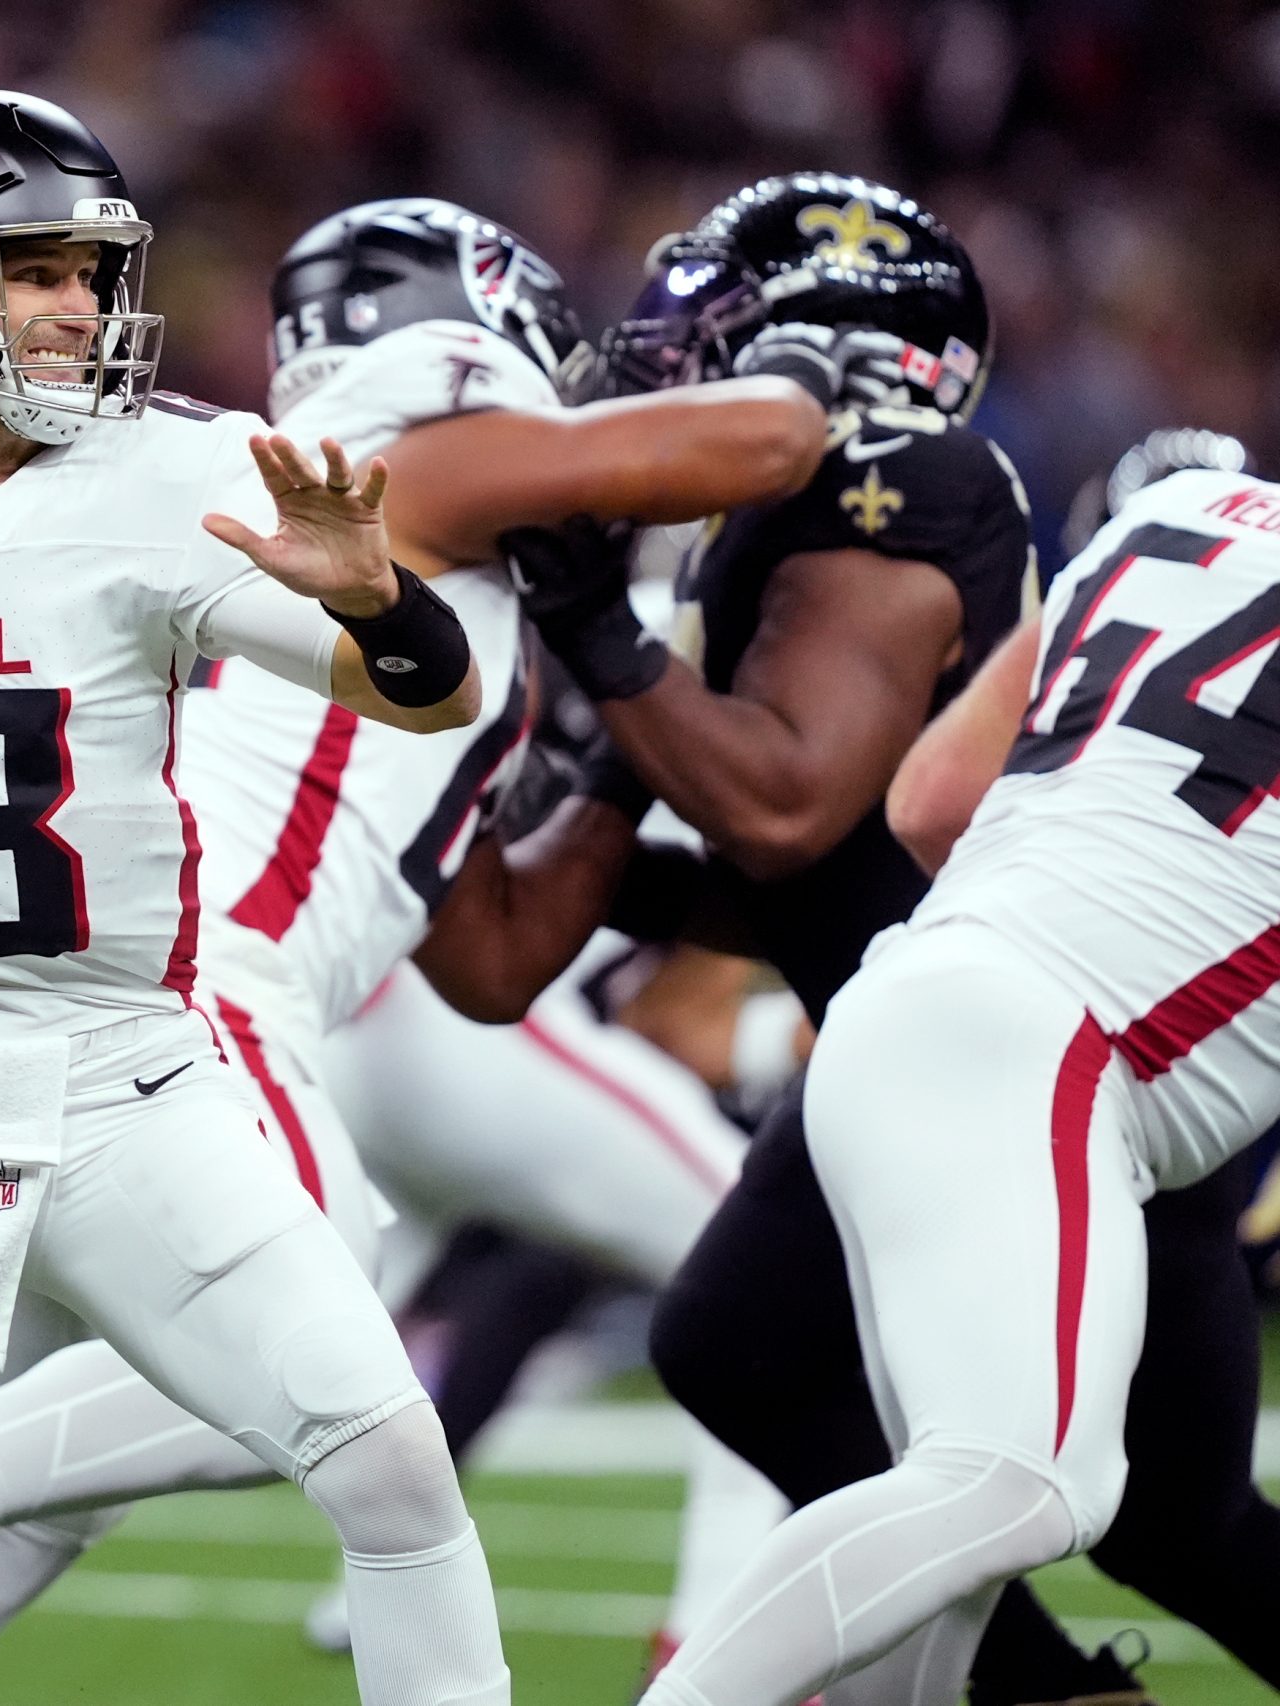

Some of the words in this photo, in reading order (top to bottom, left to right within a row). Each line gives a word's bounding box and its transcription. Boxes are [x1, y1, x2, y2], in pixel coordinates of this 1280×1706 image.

[99, 202, 131, 218] ATL
[276, 300, 327, 362] 65
[1002, 522, 1280, 839] 64
